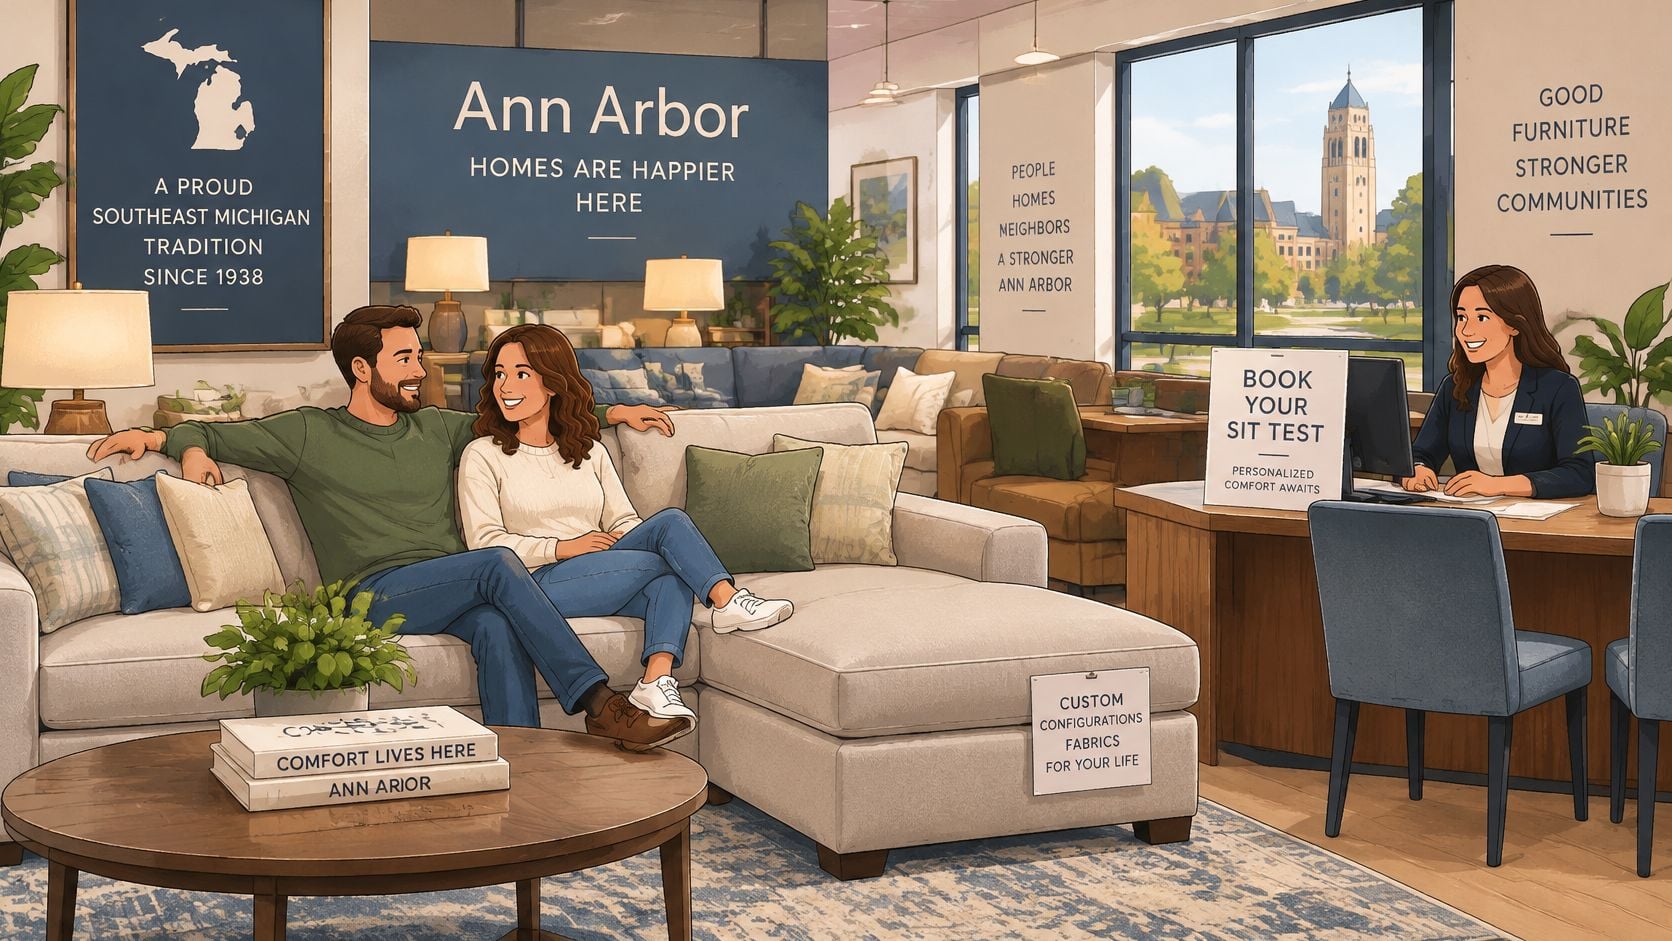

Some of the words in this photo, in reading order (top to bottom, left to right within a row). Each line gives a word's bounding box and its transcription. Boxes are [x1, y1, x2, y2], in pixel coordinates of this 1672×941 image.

[1540, 84, 1602, 106] GOOD
[453, 81, 570, 133] Ann
[590, 86, 749, 137] Arbor
[1514, 116, 1630, 142] FURNITURE
[471, 157, 562, 177] HOMES
[574, 159, 621, 178] ARE
[634, 161, 734, 181] HAPPIER
[1012, 161, 1055, 179] PEOPLE
[1516, 154, 1627, 177] STRONGER
[155, 178, 168, 194] A
[179, 178, 252, 195] PROUD
[577, 193, 642, 212] HERE
[1013, 190, 1055, 208] HOMES
[1498, 189, 1647, 212] COMMUNITIES
[93, 208, 208, 224] SOUTHEAST
[216, 209, 309, 225] MICHIGAN
[1000, 219, 1069, 237] NEIGHBORS
[144, 239, 262, 255] TRADITION
[998, 253, 1005, 266] A
[1010, 249, 1073, 265] STRONGER
[144, 269, 207, 285] SINCE
[217, 269, 263, 285] 1938
[999, 278, 1024, 292] ANN
[1029, 277, 1071, 291] ARBOR
[1244, 370, 1312, 389] BOOK
[1245, 396, 1307, 415] YOUR
[1228, 421, 1260, 439] SIT
[1269, 423, 1324, 442] TEST
[1233, 466, 1314, 479] PERSONALIZED
[1225, 481, 1275, 491] COMFORT
[1279, 484, 1319, 494] AWAITS
[1060, 693, 1123, 710] CUSTOM
[1040, 713, 1142, 730] CONFIGURATIONS
[1066, 735, 1119, 751] FABRICS
[277, 751, 369, 771] COMFORT
[376, 747, 424, 763] LIVES
[432, 743, 475, 759] HERE
[1047, 761, 1070, 773] FOR
[1075, 757, 1109, 770] YOUR
[1115, 754, 1138, 767] LIFE
[329, 781, 369, 797] ANN
